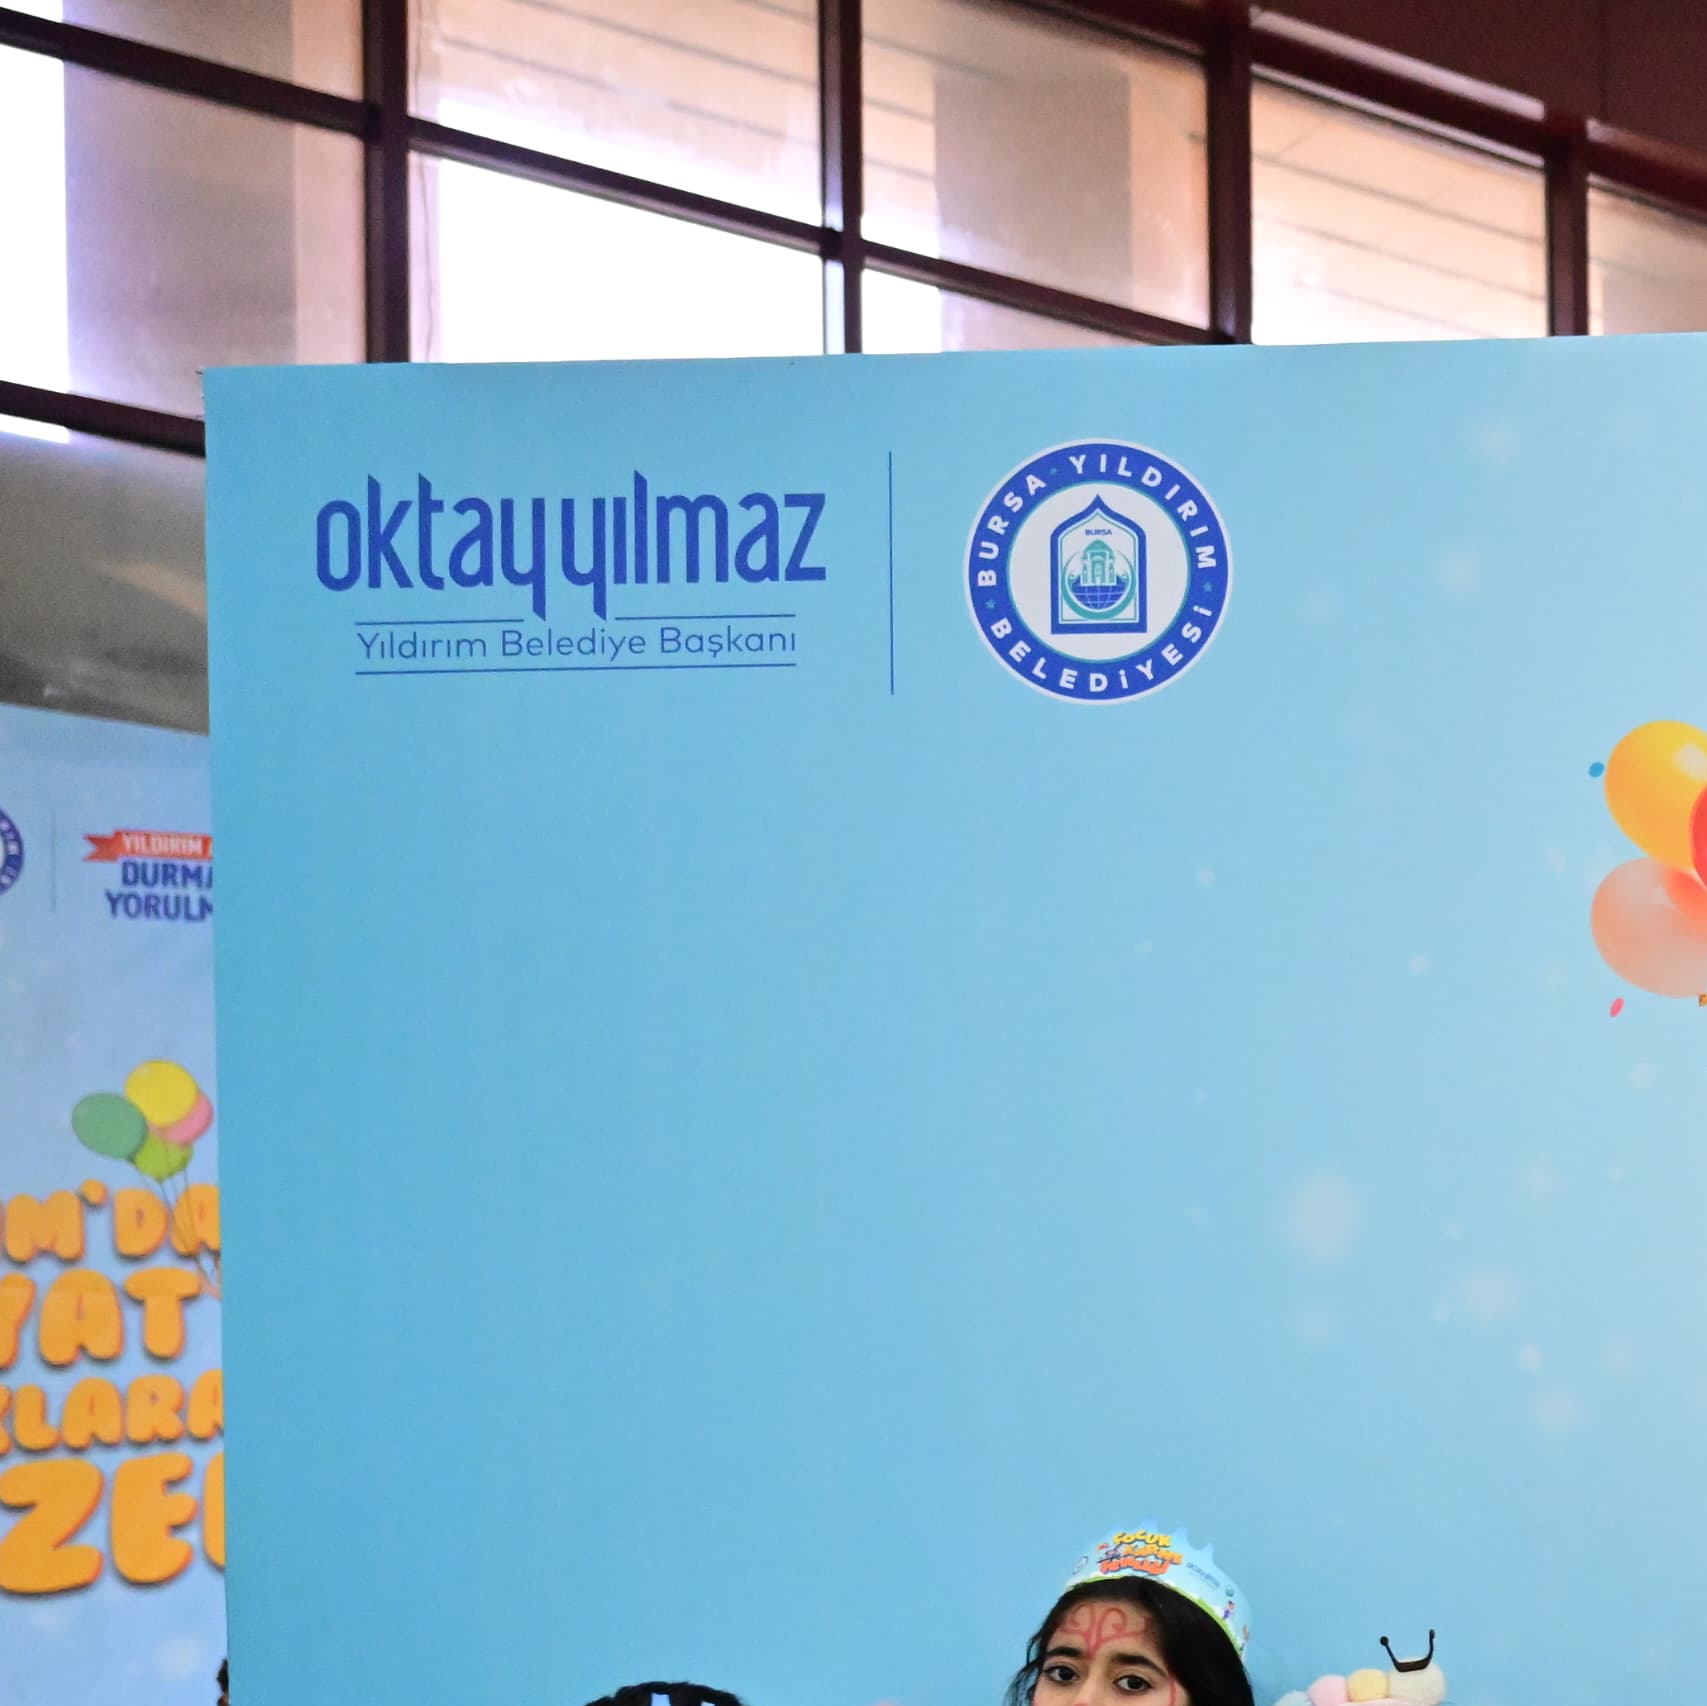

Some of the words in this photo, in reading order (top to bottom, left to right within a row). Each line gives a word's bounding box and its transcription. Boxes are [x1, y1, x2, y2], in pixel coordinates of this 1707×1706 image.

[977, 473, 1048, 587] BURSA
[1068, 453, 1218, 570] YILDIRIM
[357, 631, 488, 661] Yıldırım
[501, 627, 648, 662] Belediye
[658, 624, 797, 660] Başkanı
[990, 604, 1213, 693] BELEDİYESİ
[0, 1368, 224, 1453] LARA
